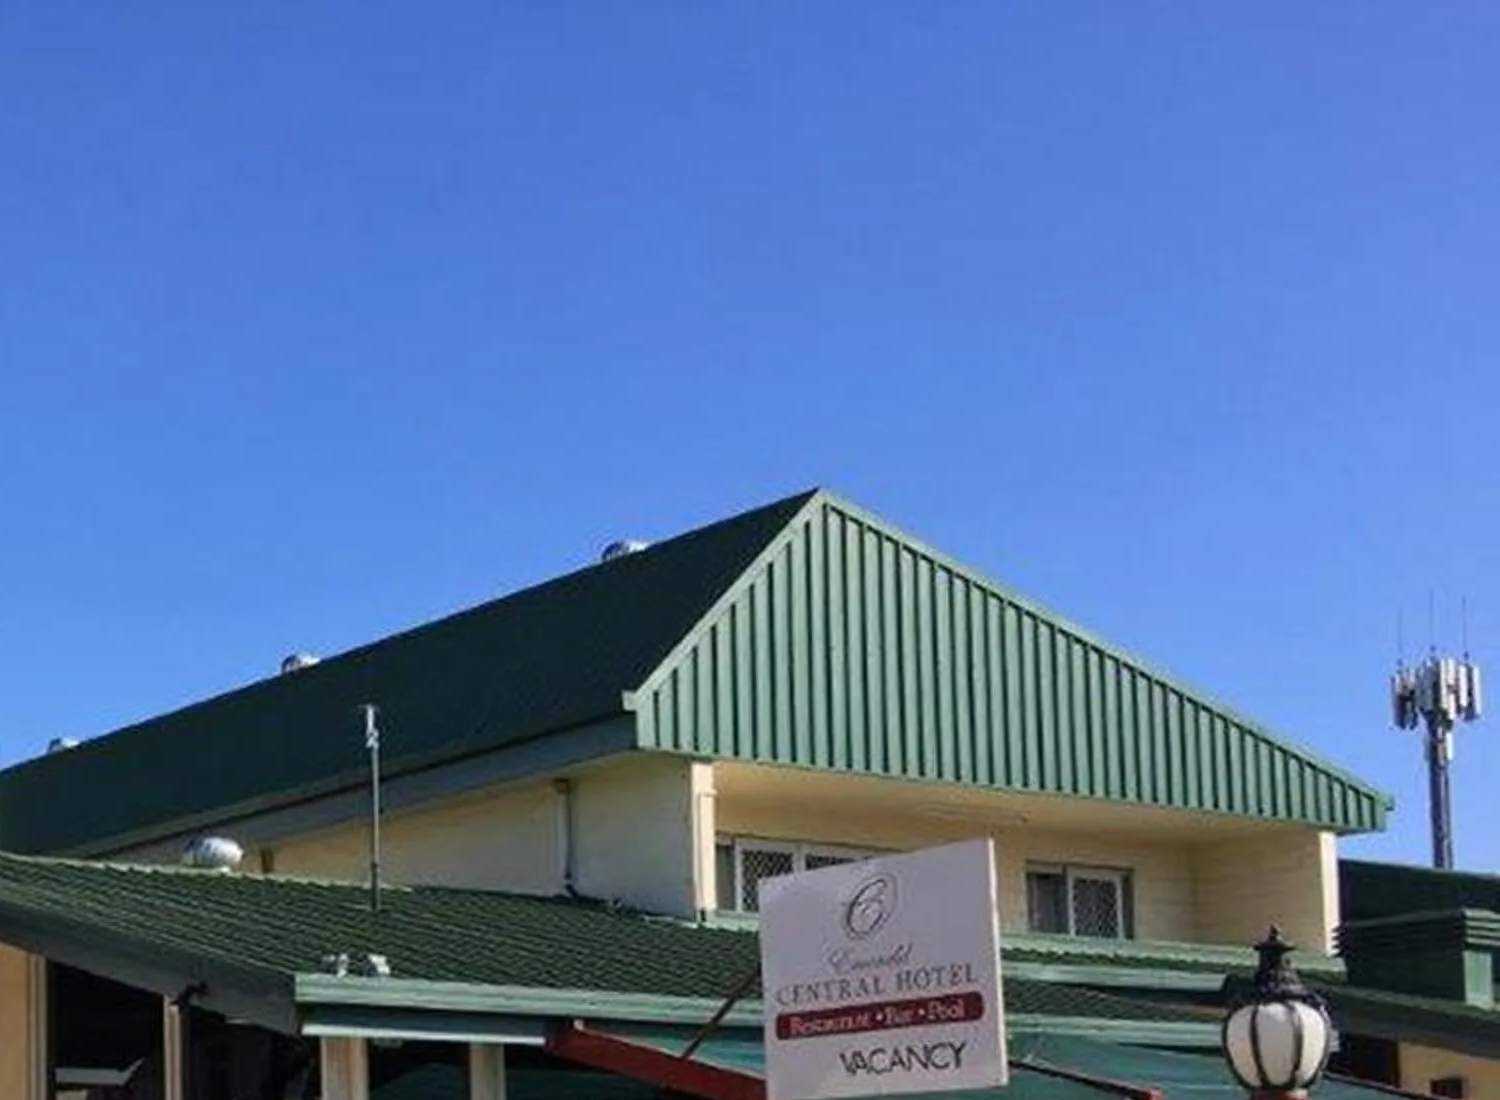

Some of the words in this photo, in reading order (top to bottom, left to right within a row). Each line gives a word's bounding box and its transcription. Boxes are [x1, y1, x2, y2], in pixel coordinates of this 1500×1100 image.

[775, 976, 885, 1006] CENTRAL
[895, 963, 978, 992] HOTEL
[927, 999, 965, 1020] Pool
[839, 1041, 967, 1077] VACANCY
